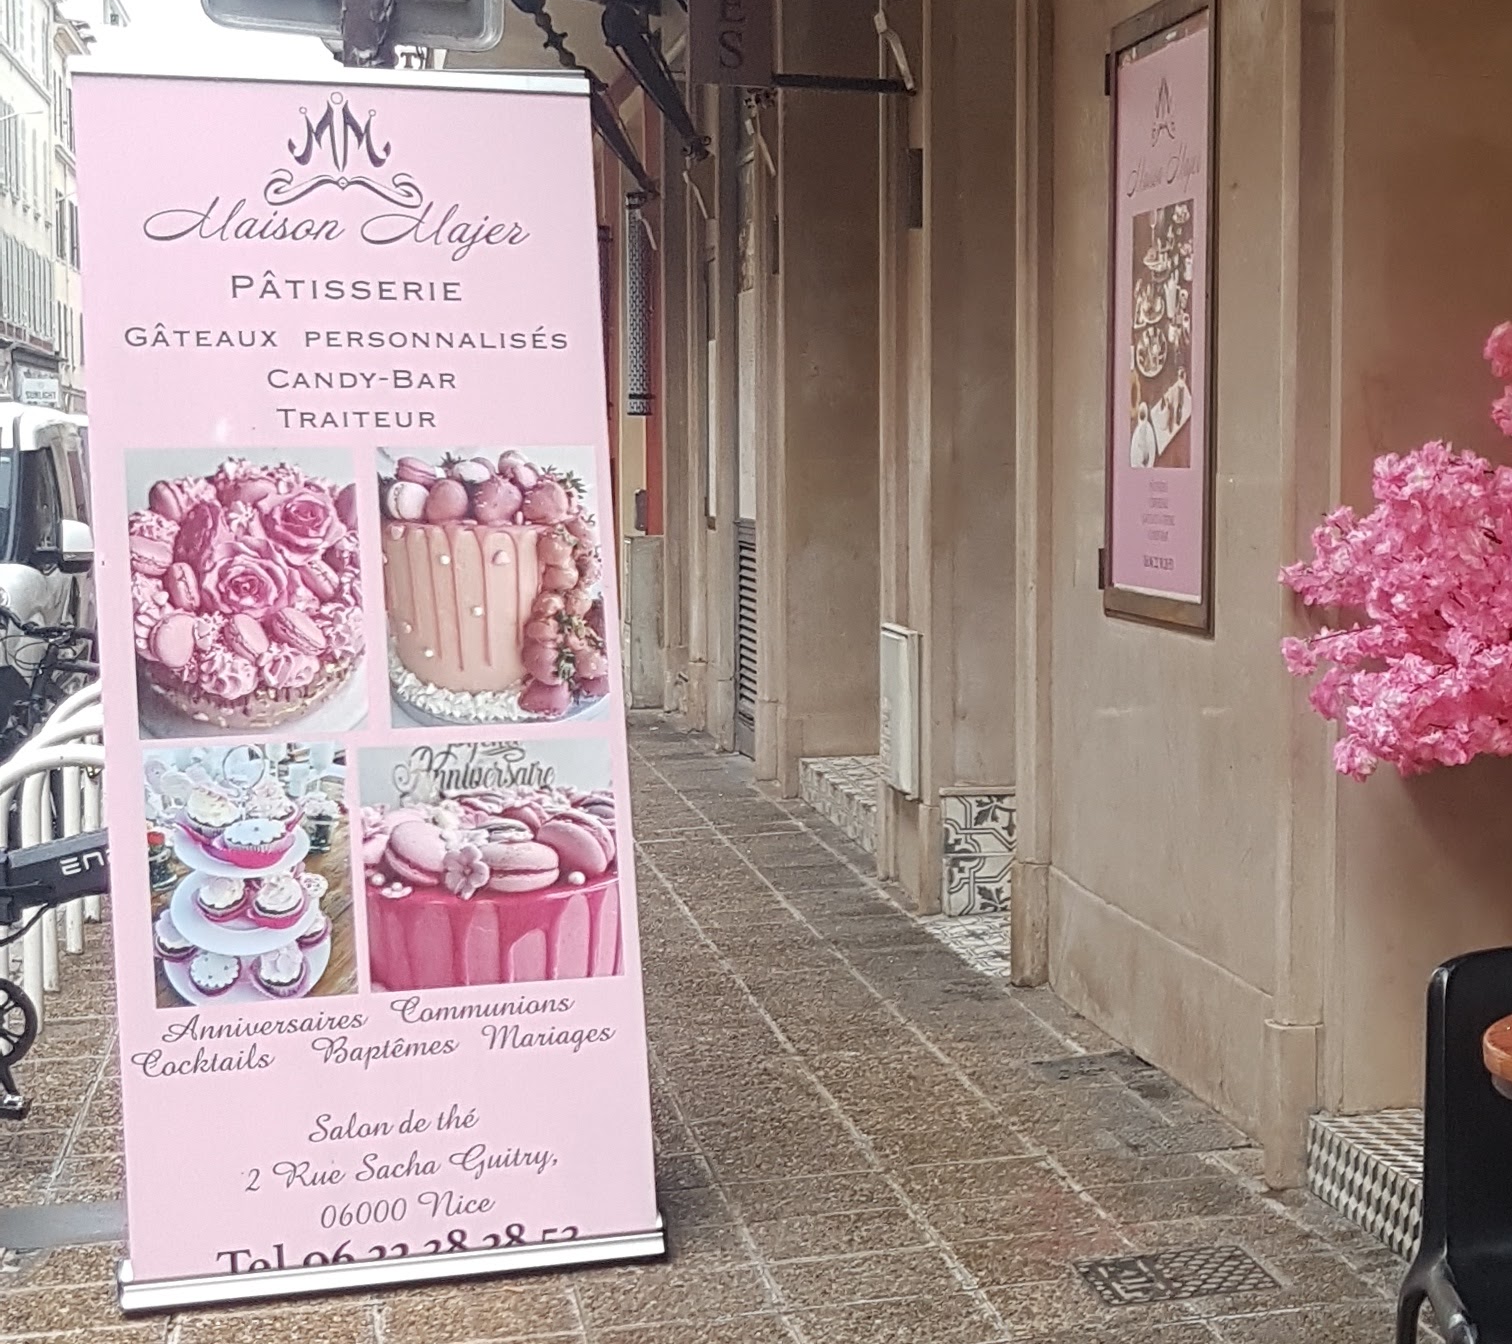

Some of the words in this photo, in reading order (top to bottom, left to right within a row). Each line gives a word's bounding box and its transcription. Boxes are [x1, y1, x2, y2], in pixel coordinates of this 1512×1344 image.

[143, 195, 346, 243] Maison
[360, 201, 531, 262] Majer
[231, 269, 462, 302] PÂTISSERIE
[124, 322, 278, 348] GÂTEAUX
[304, 325, 568, 350] PERSONNALISÉS
[267, 368, 456, 390] CANDY-BAR
[276, 408, 437, 429] TRAITEUR
[161, 1010, 369, 1044] Anniversaires
[389, 995, 576, 1024] Communions
[130, 1043, 276, 1078] Cocktails
[311, 1035, 460, 1070] Baptêmes
[481, 1023, 616, 1054] Mariages
[308, 1112, 394, 1143] Salon
[398, 1108, 432, 1134] de
[436, 1103, 480, 1131] thé
[244, 1168, 261, 1192] 2
[272, 1160, 347, 1189] Rue
[355, 1149, 441, 1182] Sacha
[448, 1143, 558, 1180] Guitry,
[320, 1197, 407, 1229] 06000
[417, 1190, 496, 1218] Nice
